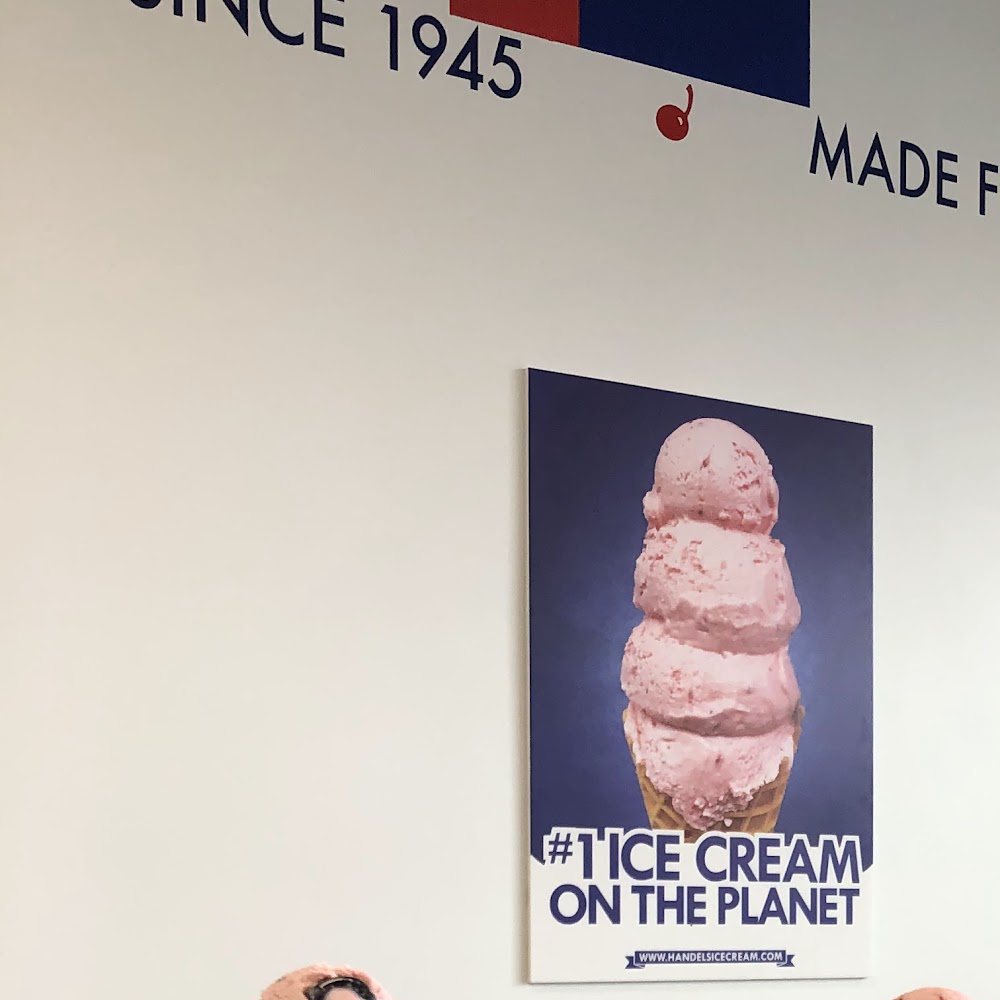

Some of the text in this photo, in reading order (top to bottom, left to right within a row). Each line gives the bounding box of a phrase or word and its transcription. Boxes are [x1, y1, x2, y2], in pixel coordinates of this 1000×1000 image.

[380, 4, 522, 99] 1945
[810, 115, 958, 209] MADE
[548, 832, 860, 884] #1 ICE CREAM
[550, 884, 860, 925] ON THE PLANET
[639, 951, 783, 963] WWW.HANDELSICECREAM.COM
